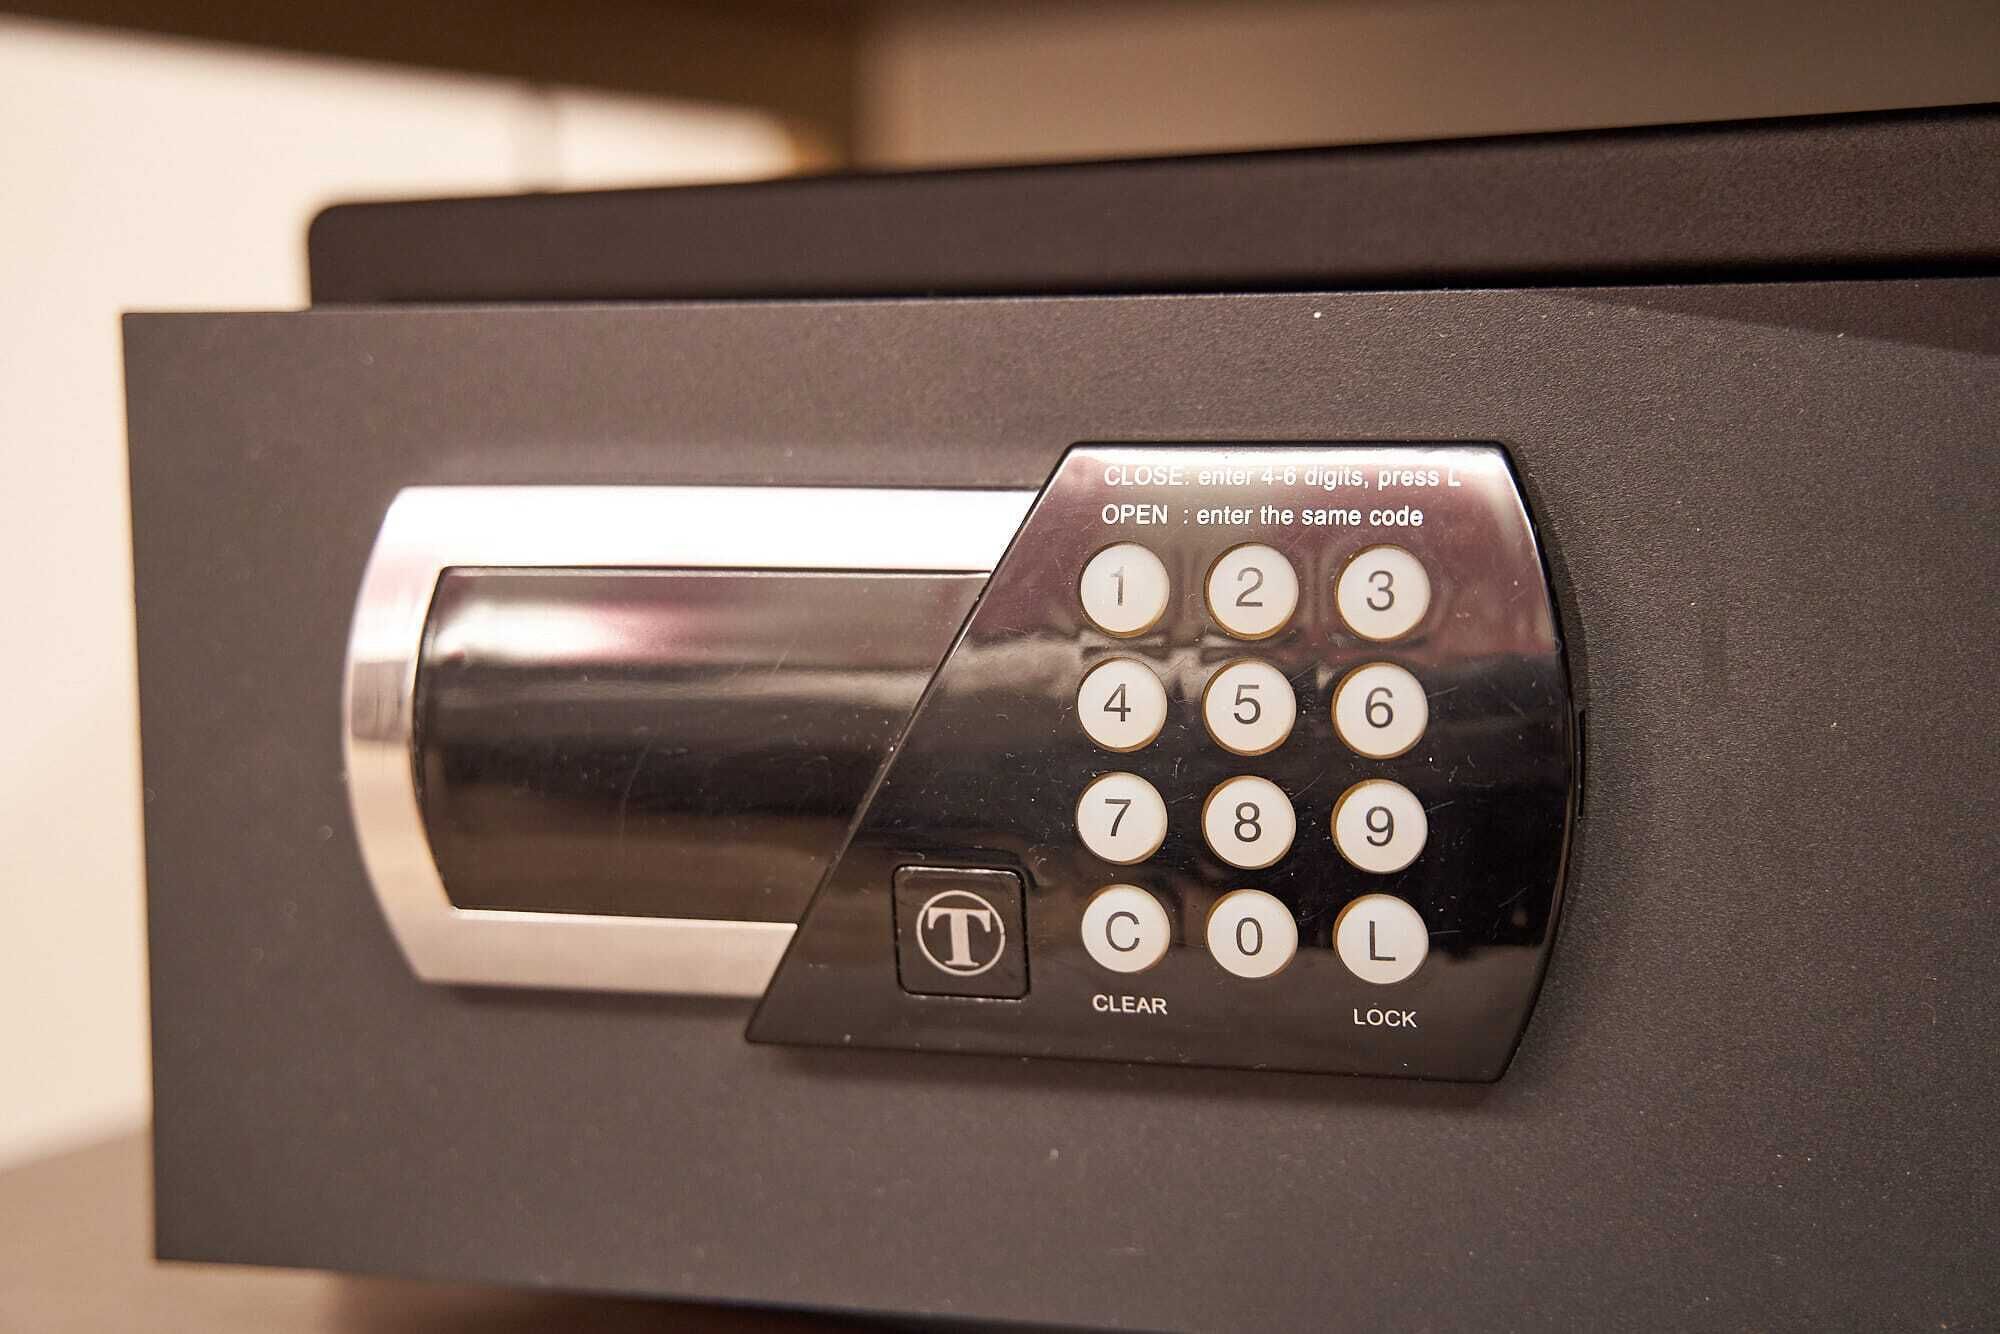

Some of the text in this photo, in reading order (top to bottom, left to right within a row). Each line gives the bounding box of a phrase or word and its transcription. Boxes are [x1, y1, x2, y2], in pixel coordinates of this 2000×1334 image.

[1198, 466, 1253, 486] enter
[1261, 465, 1297, 486] 4-6
[1304, 465, 1369, 491] digits,
[1377, 469, 1439, 491] press
[1447, 466, 1461, 487] L
[1101, 503, 1168, 525] OPEN
[1196, 506, 1255, 526] enter
[1259, 505, 1294, 526] the
[1301, 509, 1362, 527] same
[1369, 506, 1424, 527] code
[1110, 566, 1125, 606] 1
[1235, 567, 1264, 607] 2
[1366, 570, 1396, 612] 3
[1103, 683, 1132, 722] 4
[1233, 684, 1261, 725] 5
[1365, 687, 1394, 729] 6
[1104, 798, 1132, 837] 7
[1234, 801, 1262, 843] 8
[1366, 805, 1395, 847] 9
[927, 906, 992, 967] T
[1105, 911, 1140, 952] C
[1369, 920, 1397, 961] L
[1092, 993, 1168, 1016] CLEAR
[1352, 1007, 1417, 1028] LOCK
